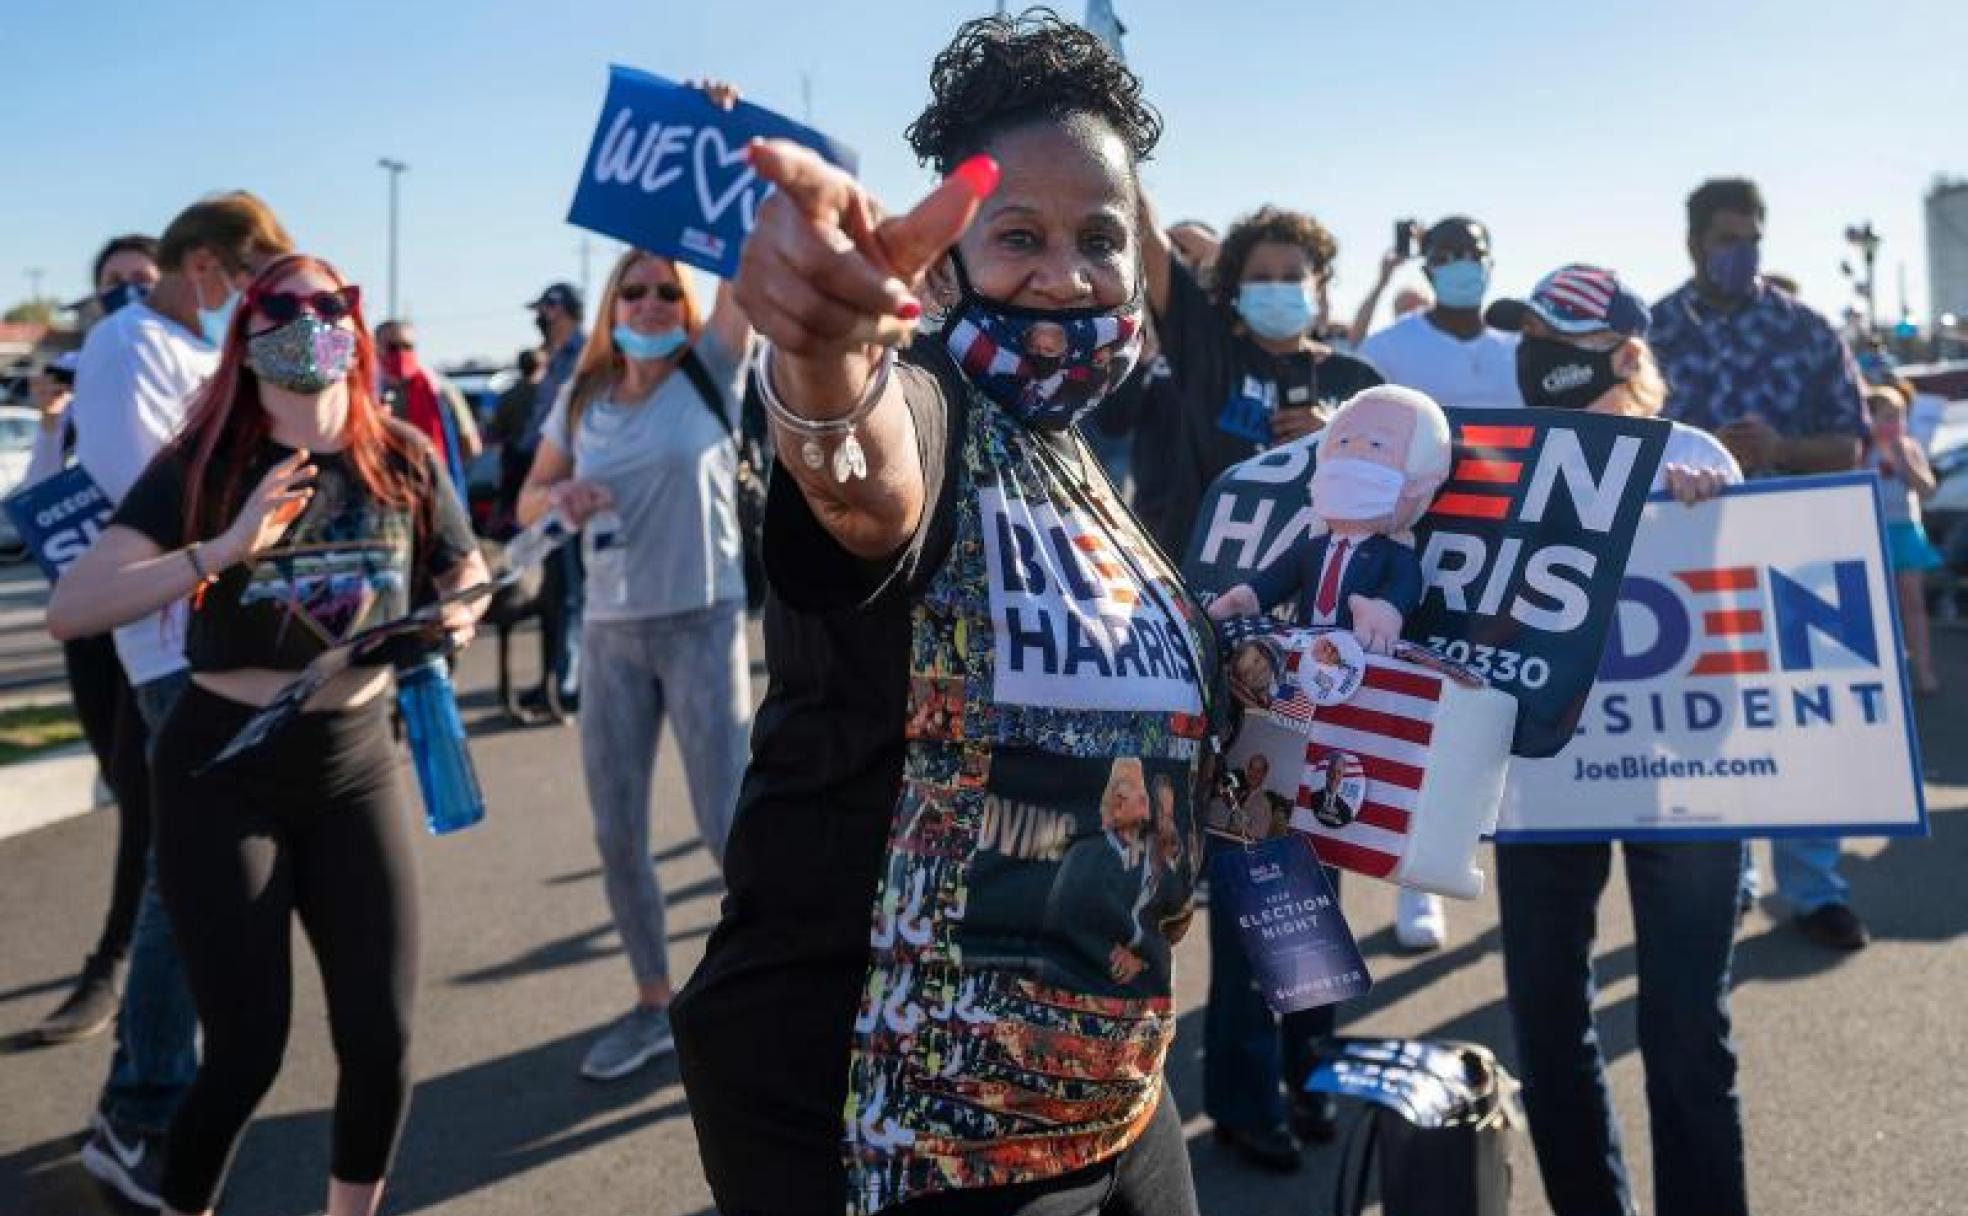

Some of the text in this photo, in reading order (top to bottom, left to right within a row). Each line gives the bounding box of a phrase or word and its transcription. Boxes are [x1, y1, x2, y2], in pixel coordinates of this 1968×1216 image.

[594, 106, 694, 192] WE
[1200, 493, 1597, 632] HRIS
[1598, 559, 1880, 682] DEN
[1576, 682, 1885, 735] SIDENT
[1575, 756, 1777, 781] JoeBiden.com
[1239, 895, 1330, 928] ELECTION
[1261, 915, 1318, 938] NIGHT
